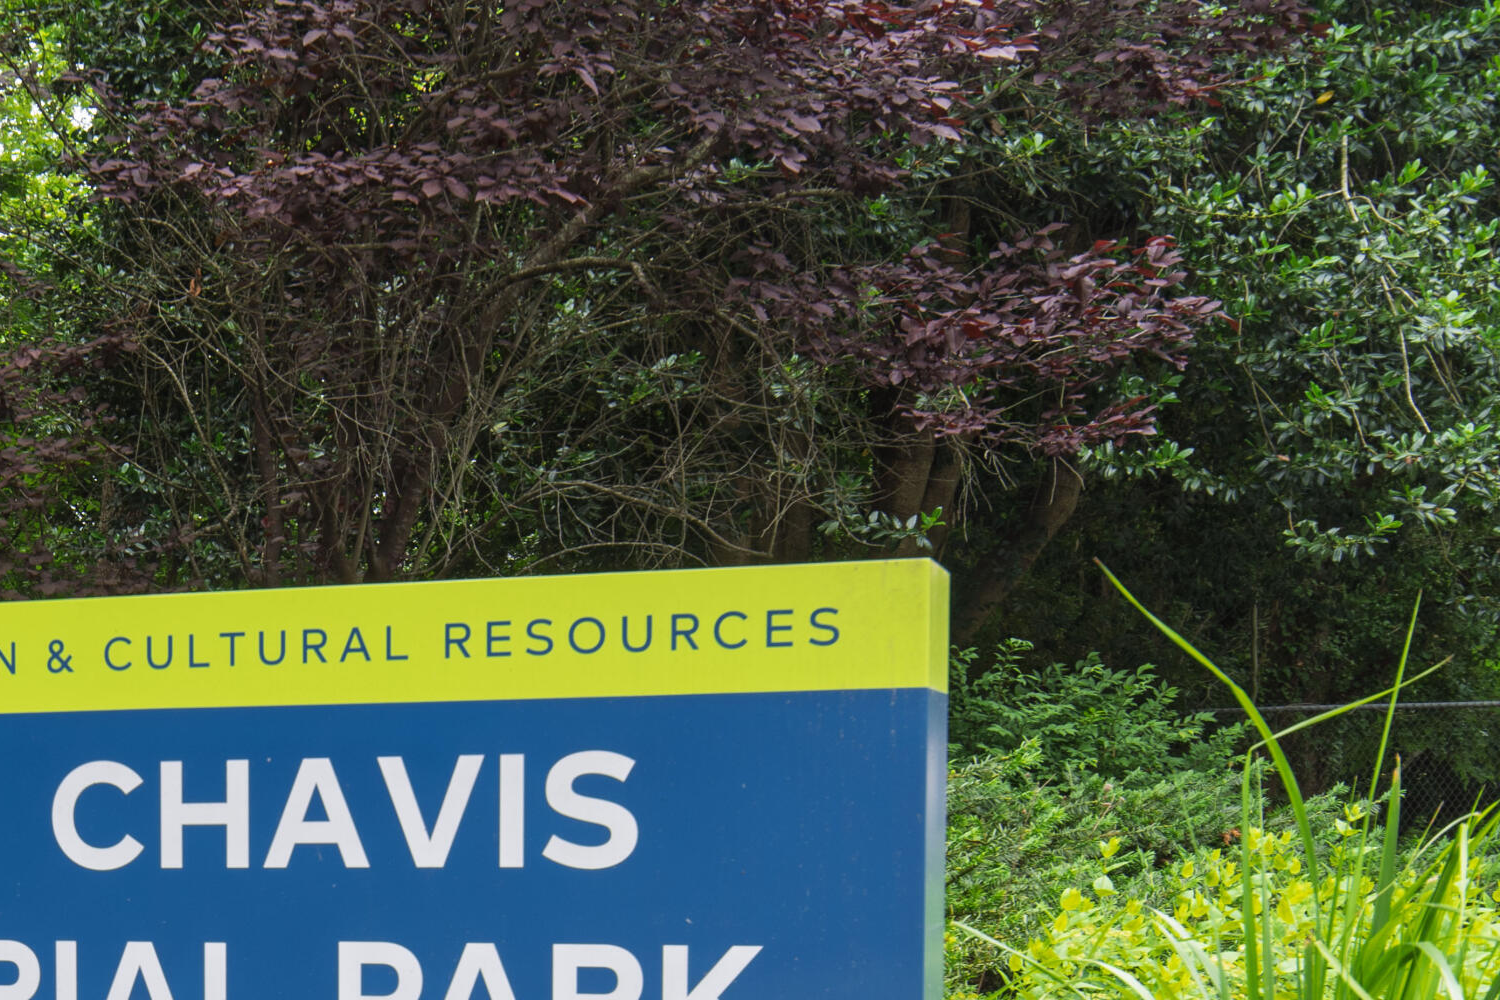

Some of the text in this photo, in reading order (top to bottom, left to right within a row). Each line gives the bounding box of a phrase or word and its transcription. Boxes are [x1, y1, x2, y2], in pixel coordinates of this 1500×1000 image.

[45, 639, 75, 674] &
[103, 625, 411, 672] CULTURAL
[443, 607, 841, 659] RESOURCES
[50, 750, 640, 872] CHAVIS
